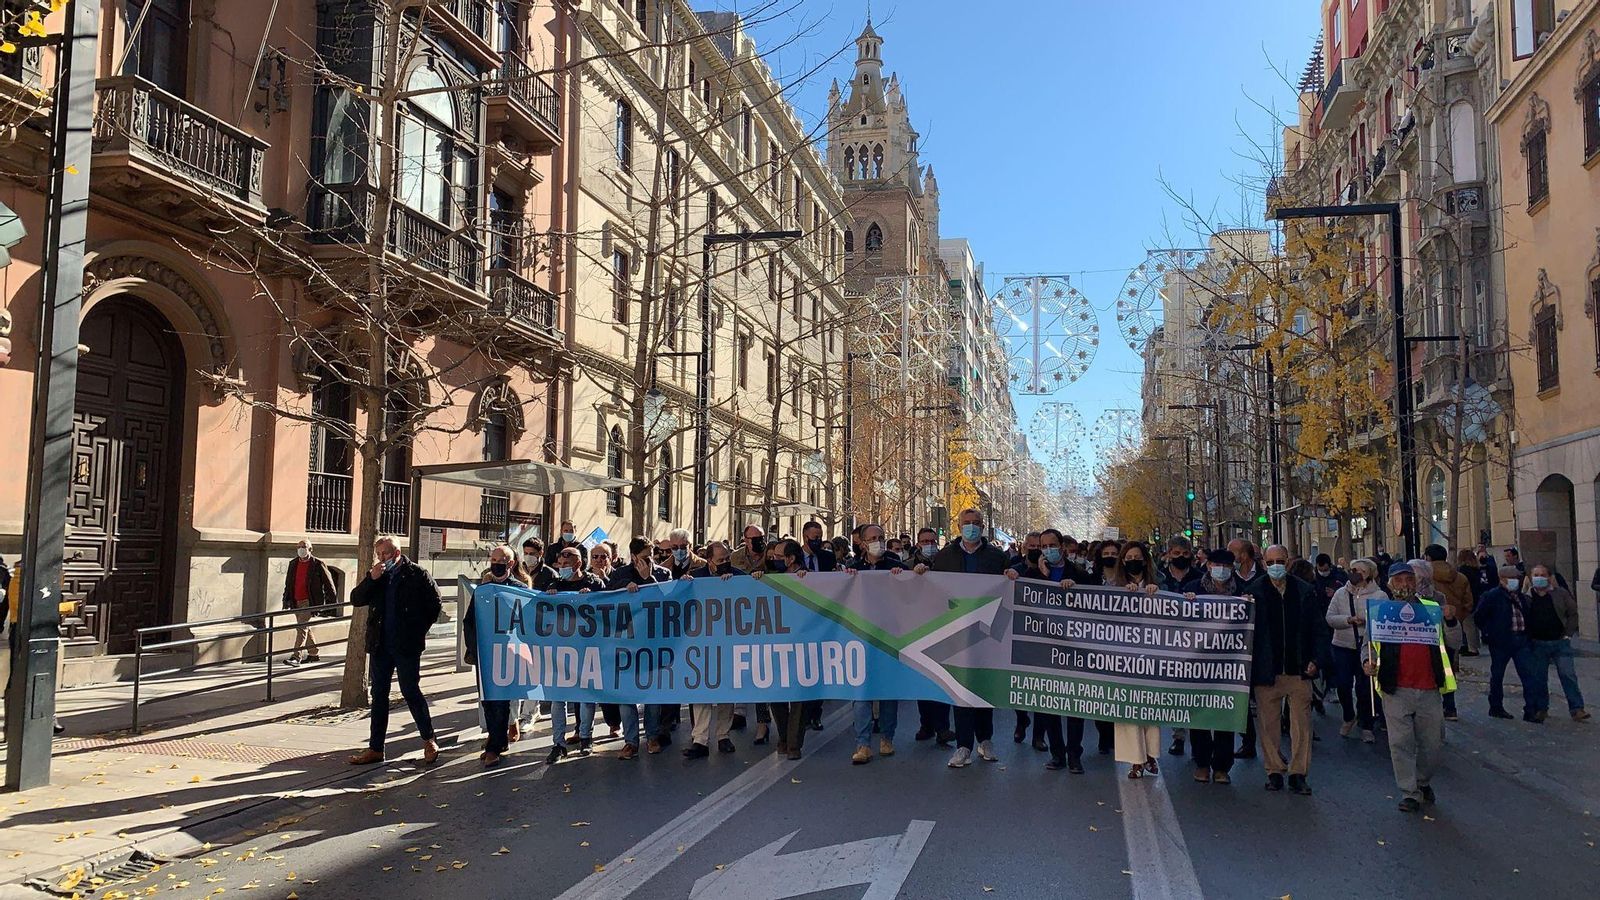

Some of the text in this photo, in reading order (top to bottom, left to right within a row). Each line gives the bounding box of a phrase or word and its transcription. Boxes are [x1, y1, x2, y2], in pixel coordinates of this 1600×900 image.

[494, 596, 791, 640] LA COSTA TROPICAL
[1023, 585, 1249, 620] Por las CANALIZACIONES DE RULES.
[1024, 615, 1248, 650] Por los ESPIGONES EN LAS PLAYAS.
[492, 640, 867, 690] UNIDA POR SU FUTURO
[1051, 647, 1247, 680] Por la CONEXIÓN FERROVIARIA
[1009, 691, 1191, 723] DE LA COSTA TROPICAL DE GRANADA
[1010, 675, 1235, 710] PLATAFORMA PARA LAS INFRAESTRUCTURAS
